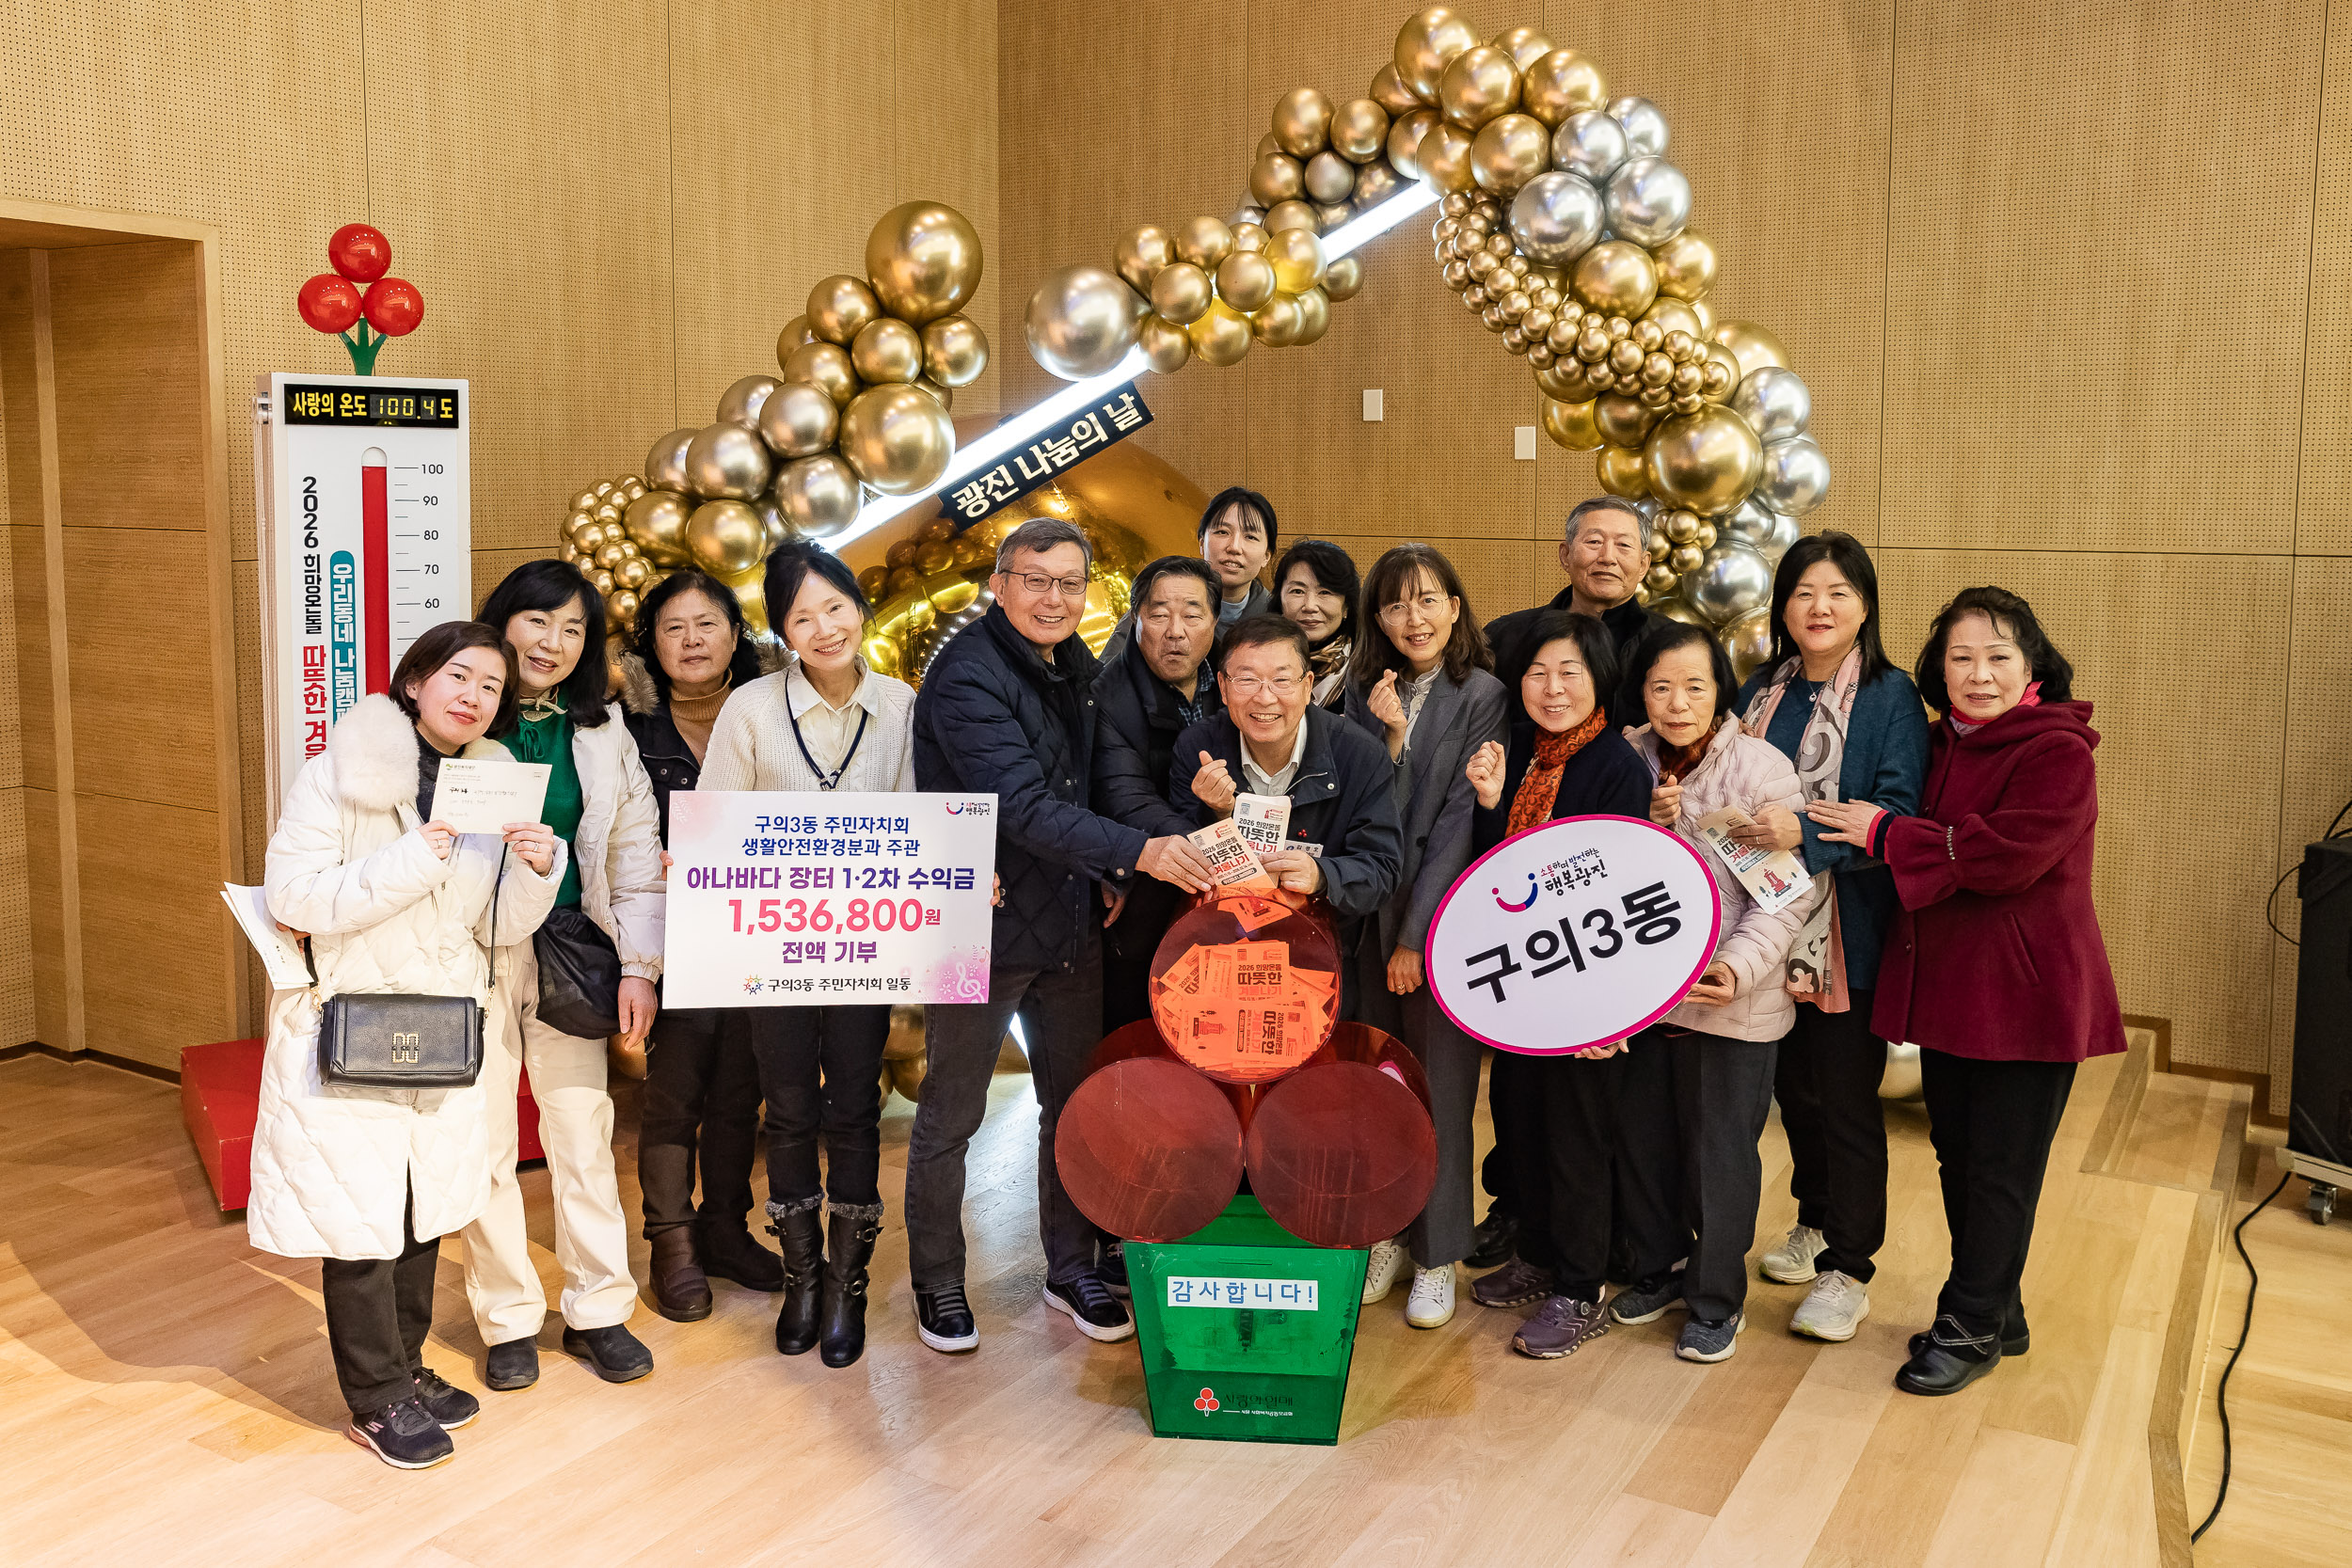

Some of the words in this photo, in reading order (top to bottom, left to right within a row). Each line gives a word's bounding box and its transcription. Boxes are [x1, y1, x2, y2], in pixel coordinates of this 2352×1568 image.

[293, 391, 334, 417] 사랑의
[340, 393, 367, 417] 온도
[440, 398, 453, 419] 도
[951, 464, 1020, 518] 광진
[1013, 412, 1108, 480] 나눔의
[1103, 392, 1143, 432] 날
[421, 464, 444, 475] 100
[302, 476, 319, 548] 2026
[422, 495, 438, 506] 90
[423, 530, 439, 541] 80
[424, 563, 439, 575] 70
[303, 553, 322, 635] 희망온돌
[332, 563, 355, 642] 우리동네
[424, 597, 440, 609] 60
[303, 644, 327, 715] 따뜻한
[334, 648, 356, 718] 나눔캠
[755, 816, 818, 834] 구의3동
[823, 816, 909, 834] 주민자치회
[741, 838, 882, 857] 생활안전환경분과
[886, 839, 921, 857] 주관
[1541, 860, 1569, 878] 소통하며
[1568, 847, 1600, 868] 발전하는
[687, 866, 782, 890] 아나바다
[789, 866, 834, 890] 장터
[842, 867, 901, 890] 1·2차
[907, 867, 976, 890] 수익금
[1544, 858, 1609, 896] 행복광진
[728, 897, 941, 935] 1,536,800원
[782, 941, 826, 964] 전액
[834, 941, 878, 964] 기부
[1464, 880, 1682, 1004] 구의3동
[768, 978, 815, 992] 구의3동
[818, 977, 882, 991] 주민자치회
[886, 977, 912, 991] 일동
[1237, 972, 1282, 986] 따뜻한
[1262, 1010, 1277, 1055] 따뜻한
[1171, 1280, 1313, 1305] 감사합니다!
